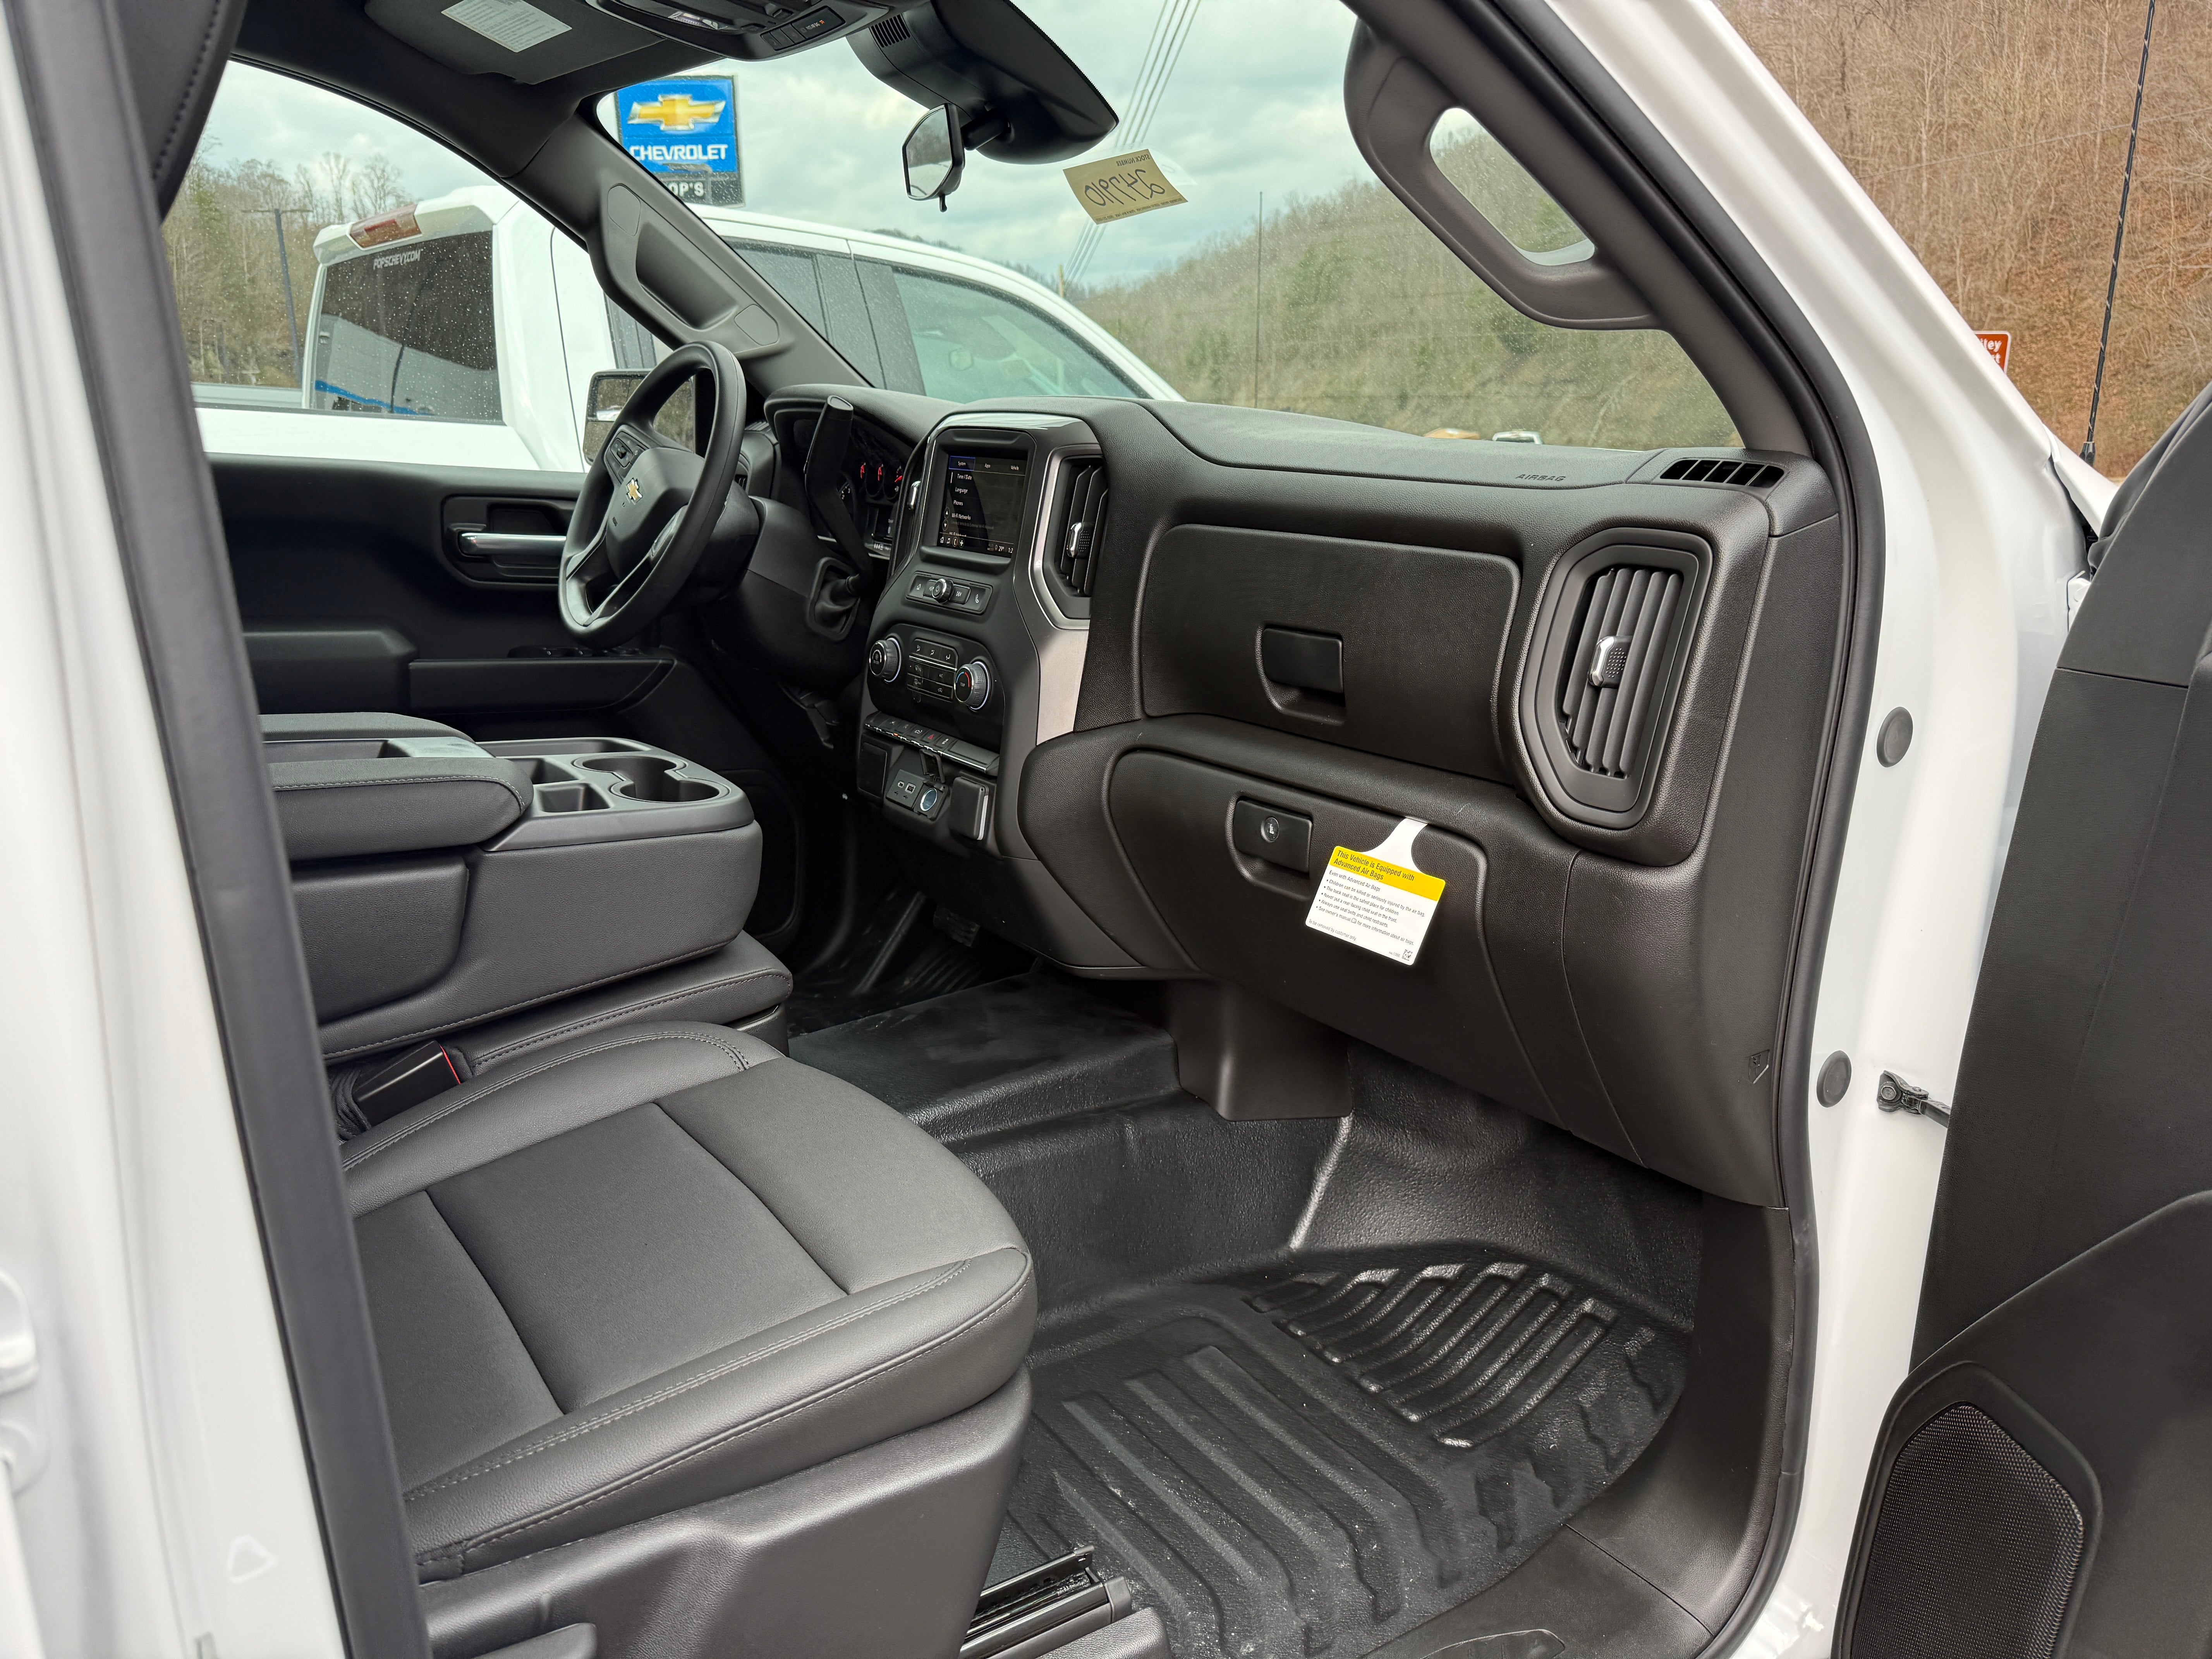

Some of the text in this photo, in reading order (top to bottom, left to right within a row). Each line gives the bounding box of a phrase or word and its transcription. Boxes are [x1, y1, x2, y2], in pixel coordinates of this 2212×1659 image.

[629, 144, 728, 161] CHEVROLET
[668, 181, 704, 197] OP'S
[1333, 858, 1361, 872] Advanced
[1369, 870, 1384, 880] Bags
[1337, 850, 1349, 859] This
[1350, 854, 1369, 866] Vehicle
[1376, 863, 1401, 877] Equipped
[1402, 873, 1414, 881] with
